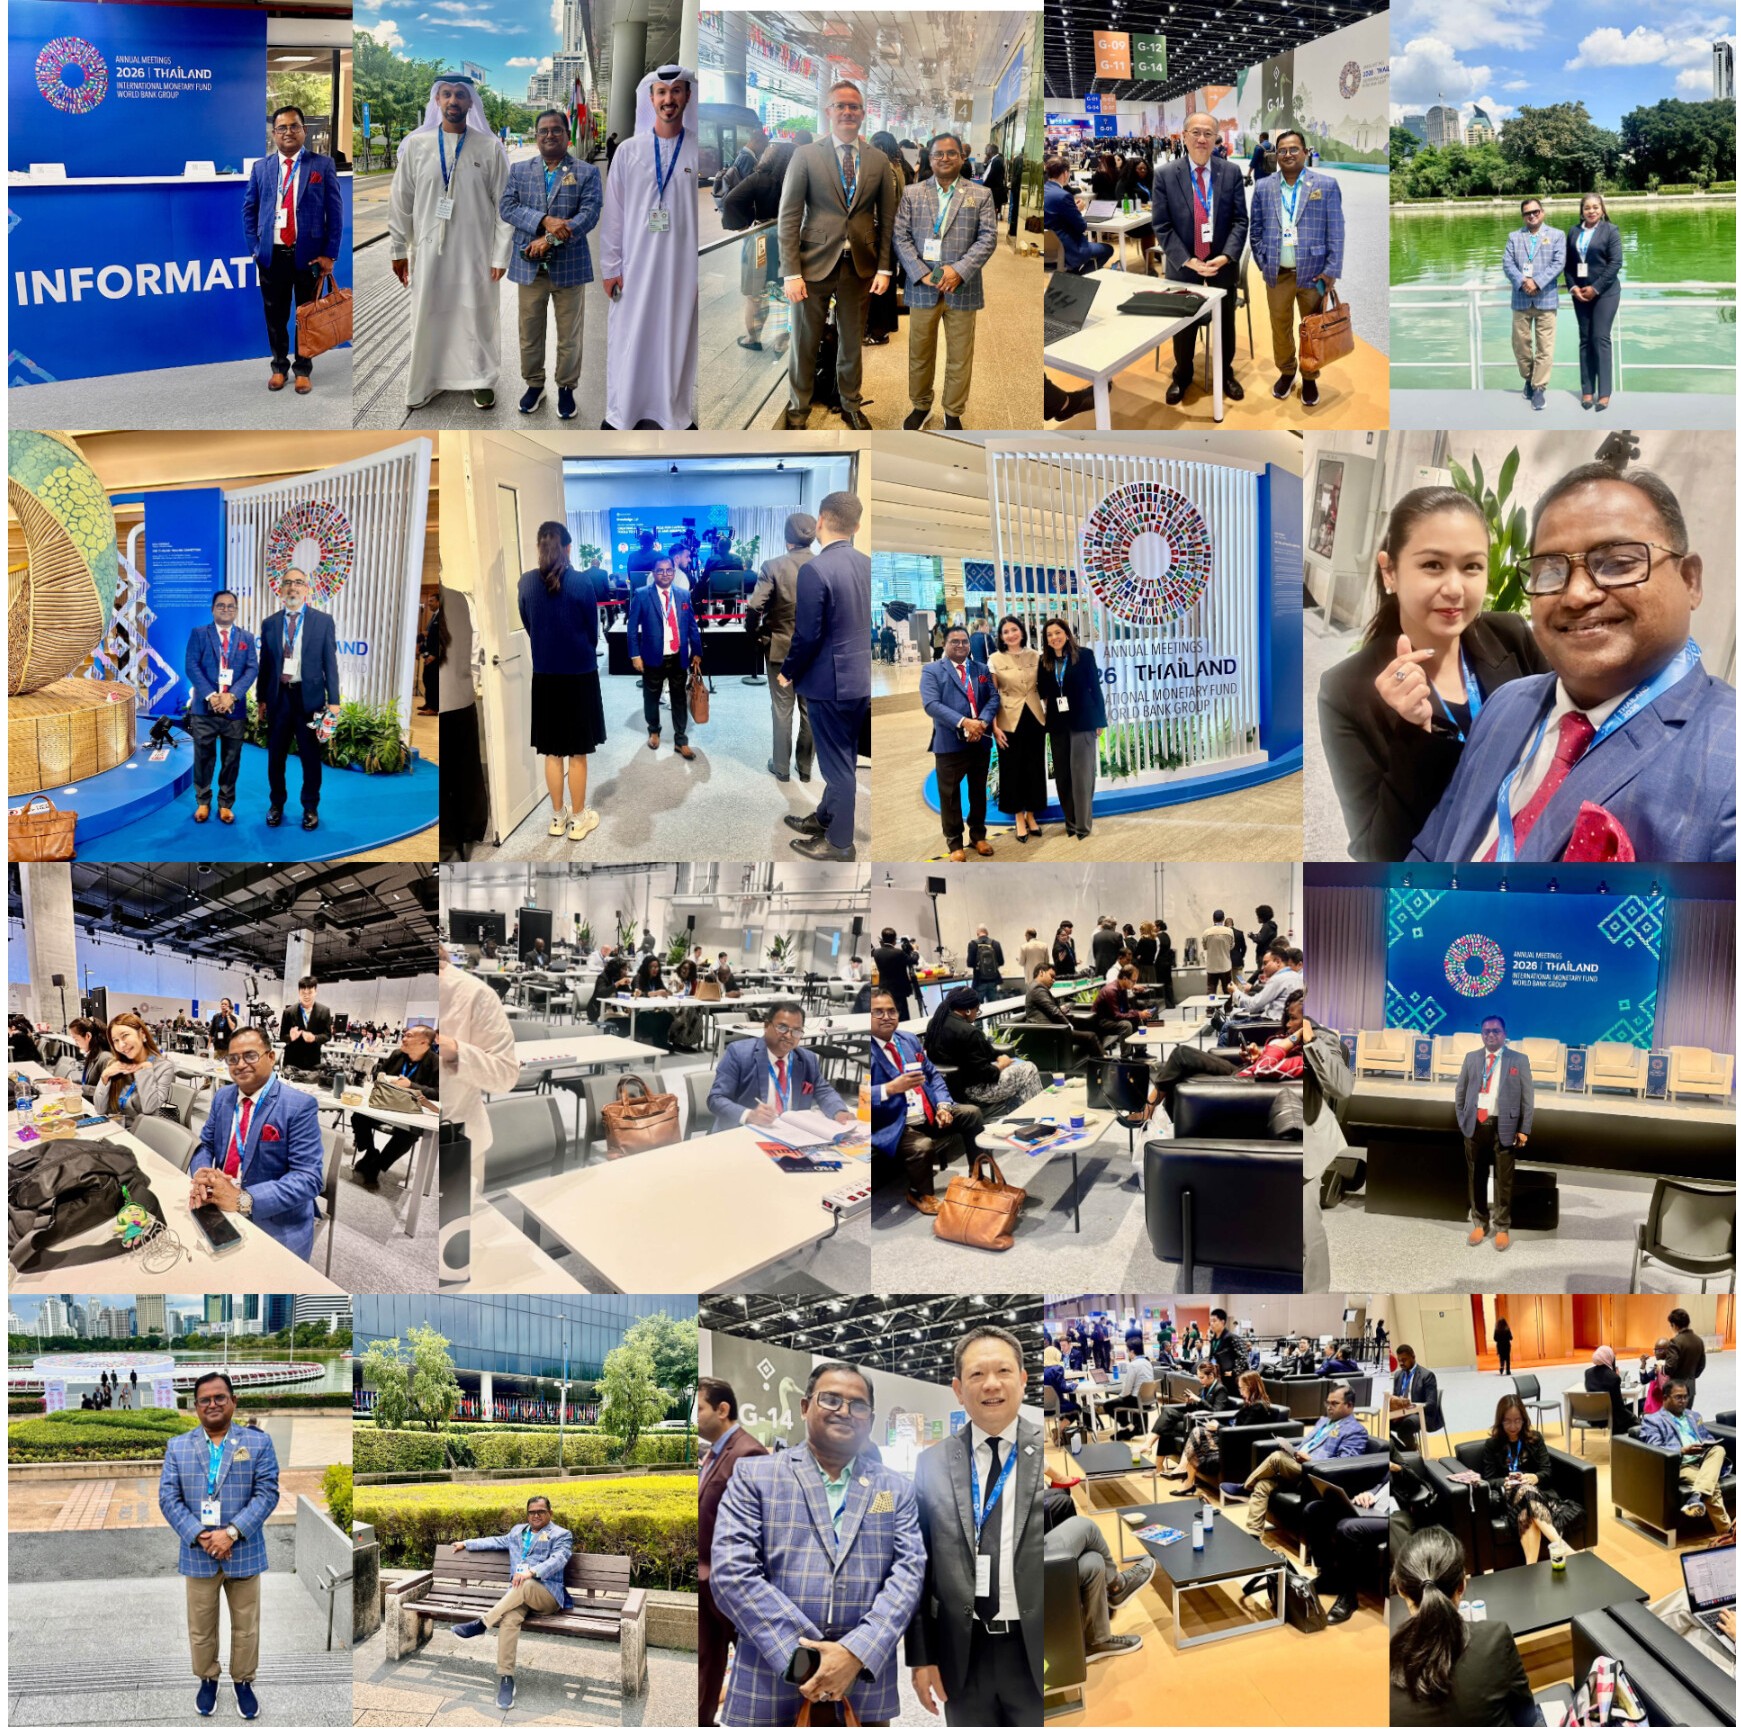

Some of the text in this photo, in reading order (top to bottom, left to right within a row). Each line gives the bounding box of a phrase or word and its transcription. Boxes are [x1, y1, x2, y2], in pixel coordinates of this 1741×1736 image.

[1098, 40, 1126, 50] G-09
[1137, 42, 1162, 52] G-12
[116, 56, 172, 64] ANNUAL MEETINGS
[1100, 60, 1125, 71] G-11
[116, 67, 145, 78] 2026
[1138, 62, 1163, 72] G-14
[117, 82, 212, 91] INTERNATIONAL MONETARY FUND
[158, 91, 179, 99] GROUP
[1267, 96, 1285, 112] G-14
[958, 104, 968, 118] 4
[15, 256, 261, 306] INFORMAT
[950, 585, 957, 596] 3
[1104, 641, 1203, 658] ANNUAL MEETINGS
[1098, 667, 1117, 684] 26
[1105, 682, 1238, 706] ATIONAL MONETARY FUND
[1143, 703, 1171, 718] BANK
[1174, 700, 1210, 715] GROUP
[1513, 951, 1534, 959] ANNUAL
[1513, 960, 1537, 970] 2026
[1512, 972, 1552, 980] INTERNATIONAL
[738, 1403, 794, 1430] G-14
